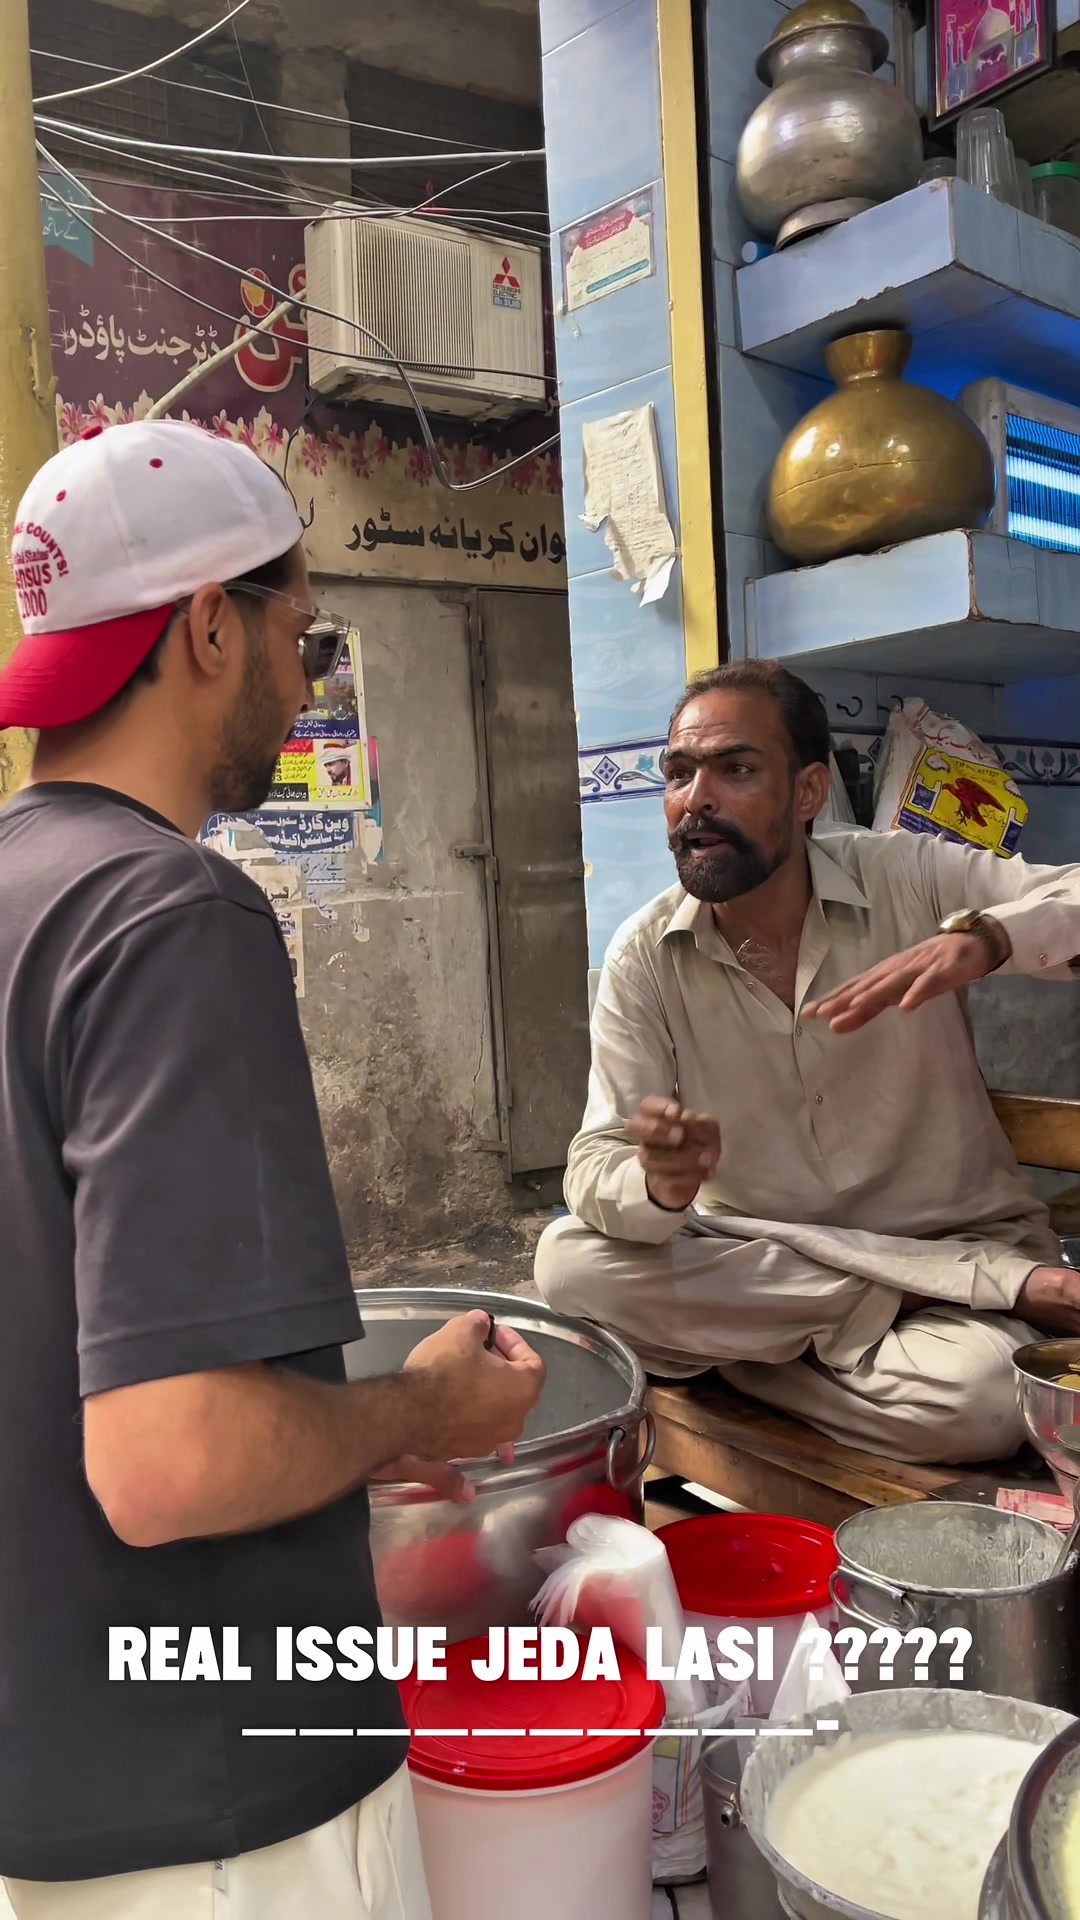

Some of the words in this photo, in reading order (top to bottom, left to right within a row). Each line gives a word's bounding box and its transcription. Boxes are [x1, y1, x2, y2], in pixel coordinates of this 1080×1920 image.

[63, 304, 126, 363] پاؤڈر
[26, 522, 69, 577] COUNTS!
[344, 507, 425, 551] سٹور
[429, 516, 514, 560] کریانہ
[520, 523, 568, 564] وان
[19, 588, 48, 619] 000
